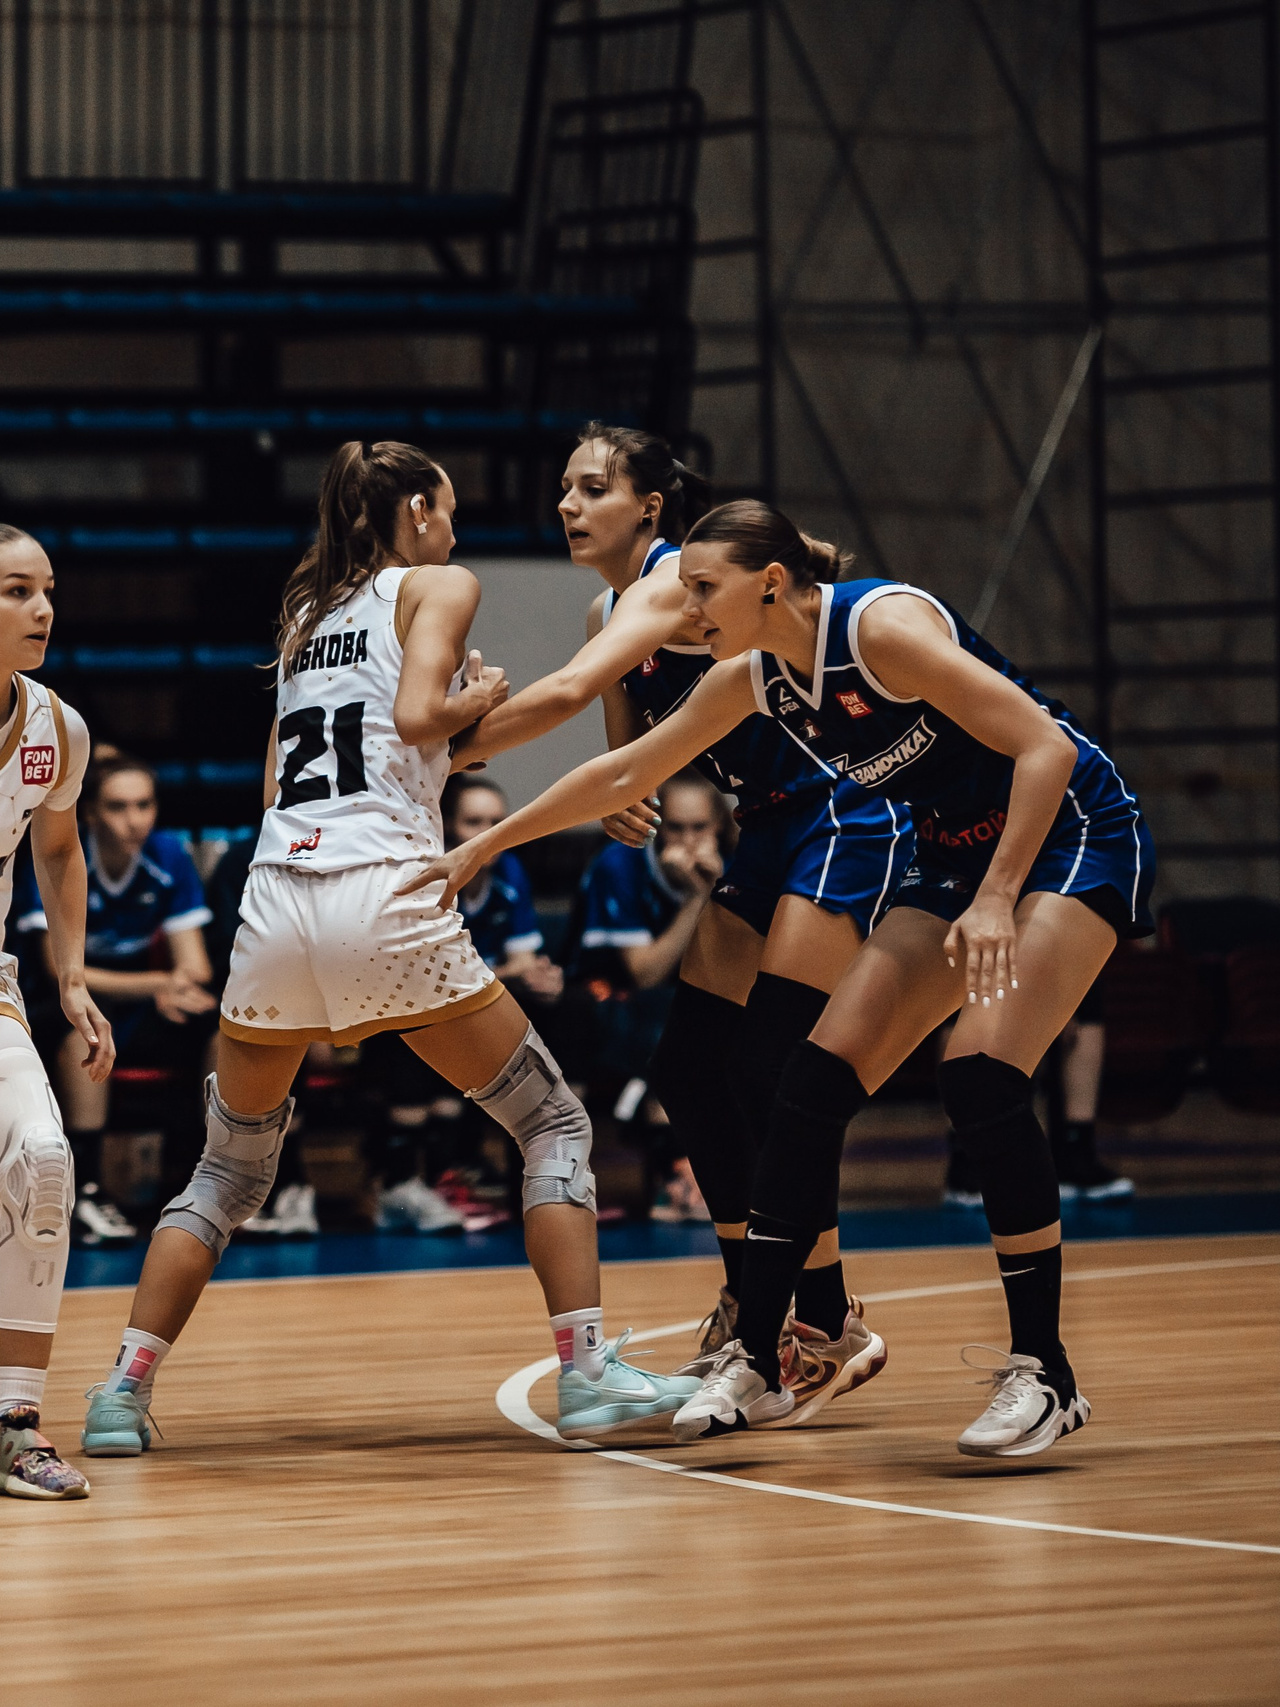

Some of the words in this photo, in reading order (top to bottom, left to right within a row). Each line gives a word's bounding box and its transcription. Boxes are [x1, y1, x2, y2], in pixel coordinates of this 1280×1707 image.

[283, 629, 368, 684] БКОВА
[840, 693, 861, 706] FON
[778, 700, 800, 716] PEA
[847, 703, 869, 716] BET
[24, 750, 53, 764] FON
[277, 701, 369, 810] 21
[835, 729, 928, 785] ЗАНОЧКА
[24, 764, 53, 780] BET
